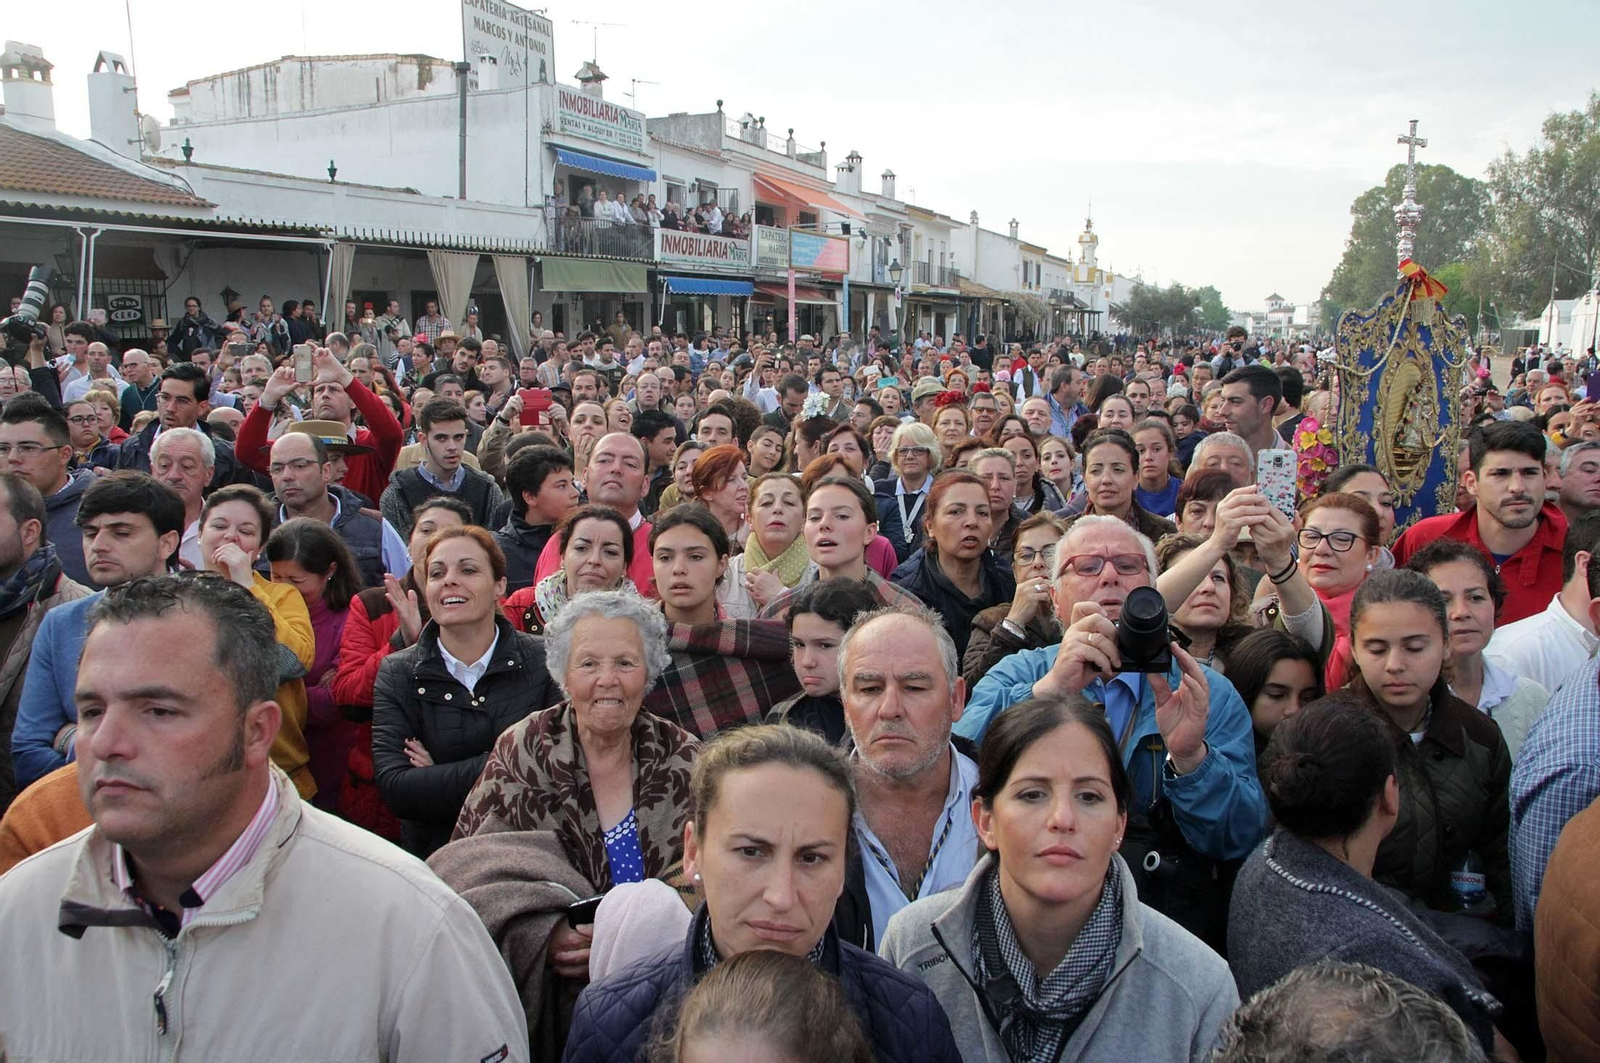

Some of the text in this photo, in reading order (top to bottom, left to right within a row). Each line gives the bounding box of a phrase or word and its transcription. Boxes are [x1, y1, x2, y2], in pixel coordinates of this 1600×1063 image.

[473, 15, 506, 40] MARCOS
[507, 29, 513, 43] Y
[514, 33, 546, 55] ANTONIO
[558, 89, 619, 125] INMOBILIARIA
[588, 125, 613, 139] ALQUIER
[661, 233, 728, 259] INMOBILIARIA
[114, 311, 138, 319] CERO
